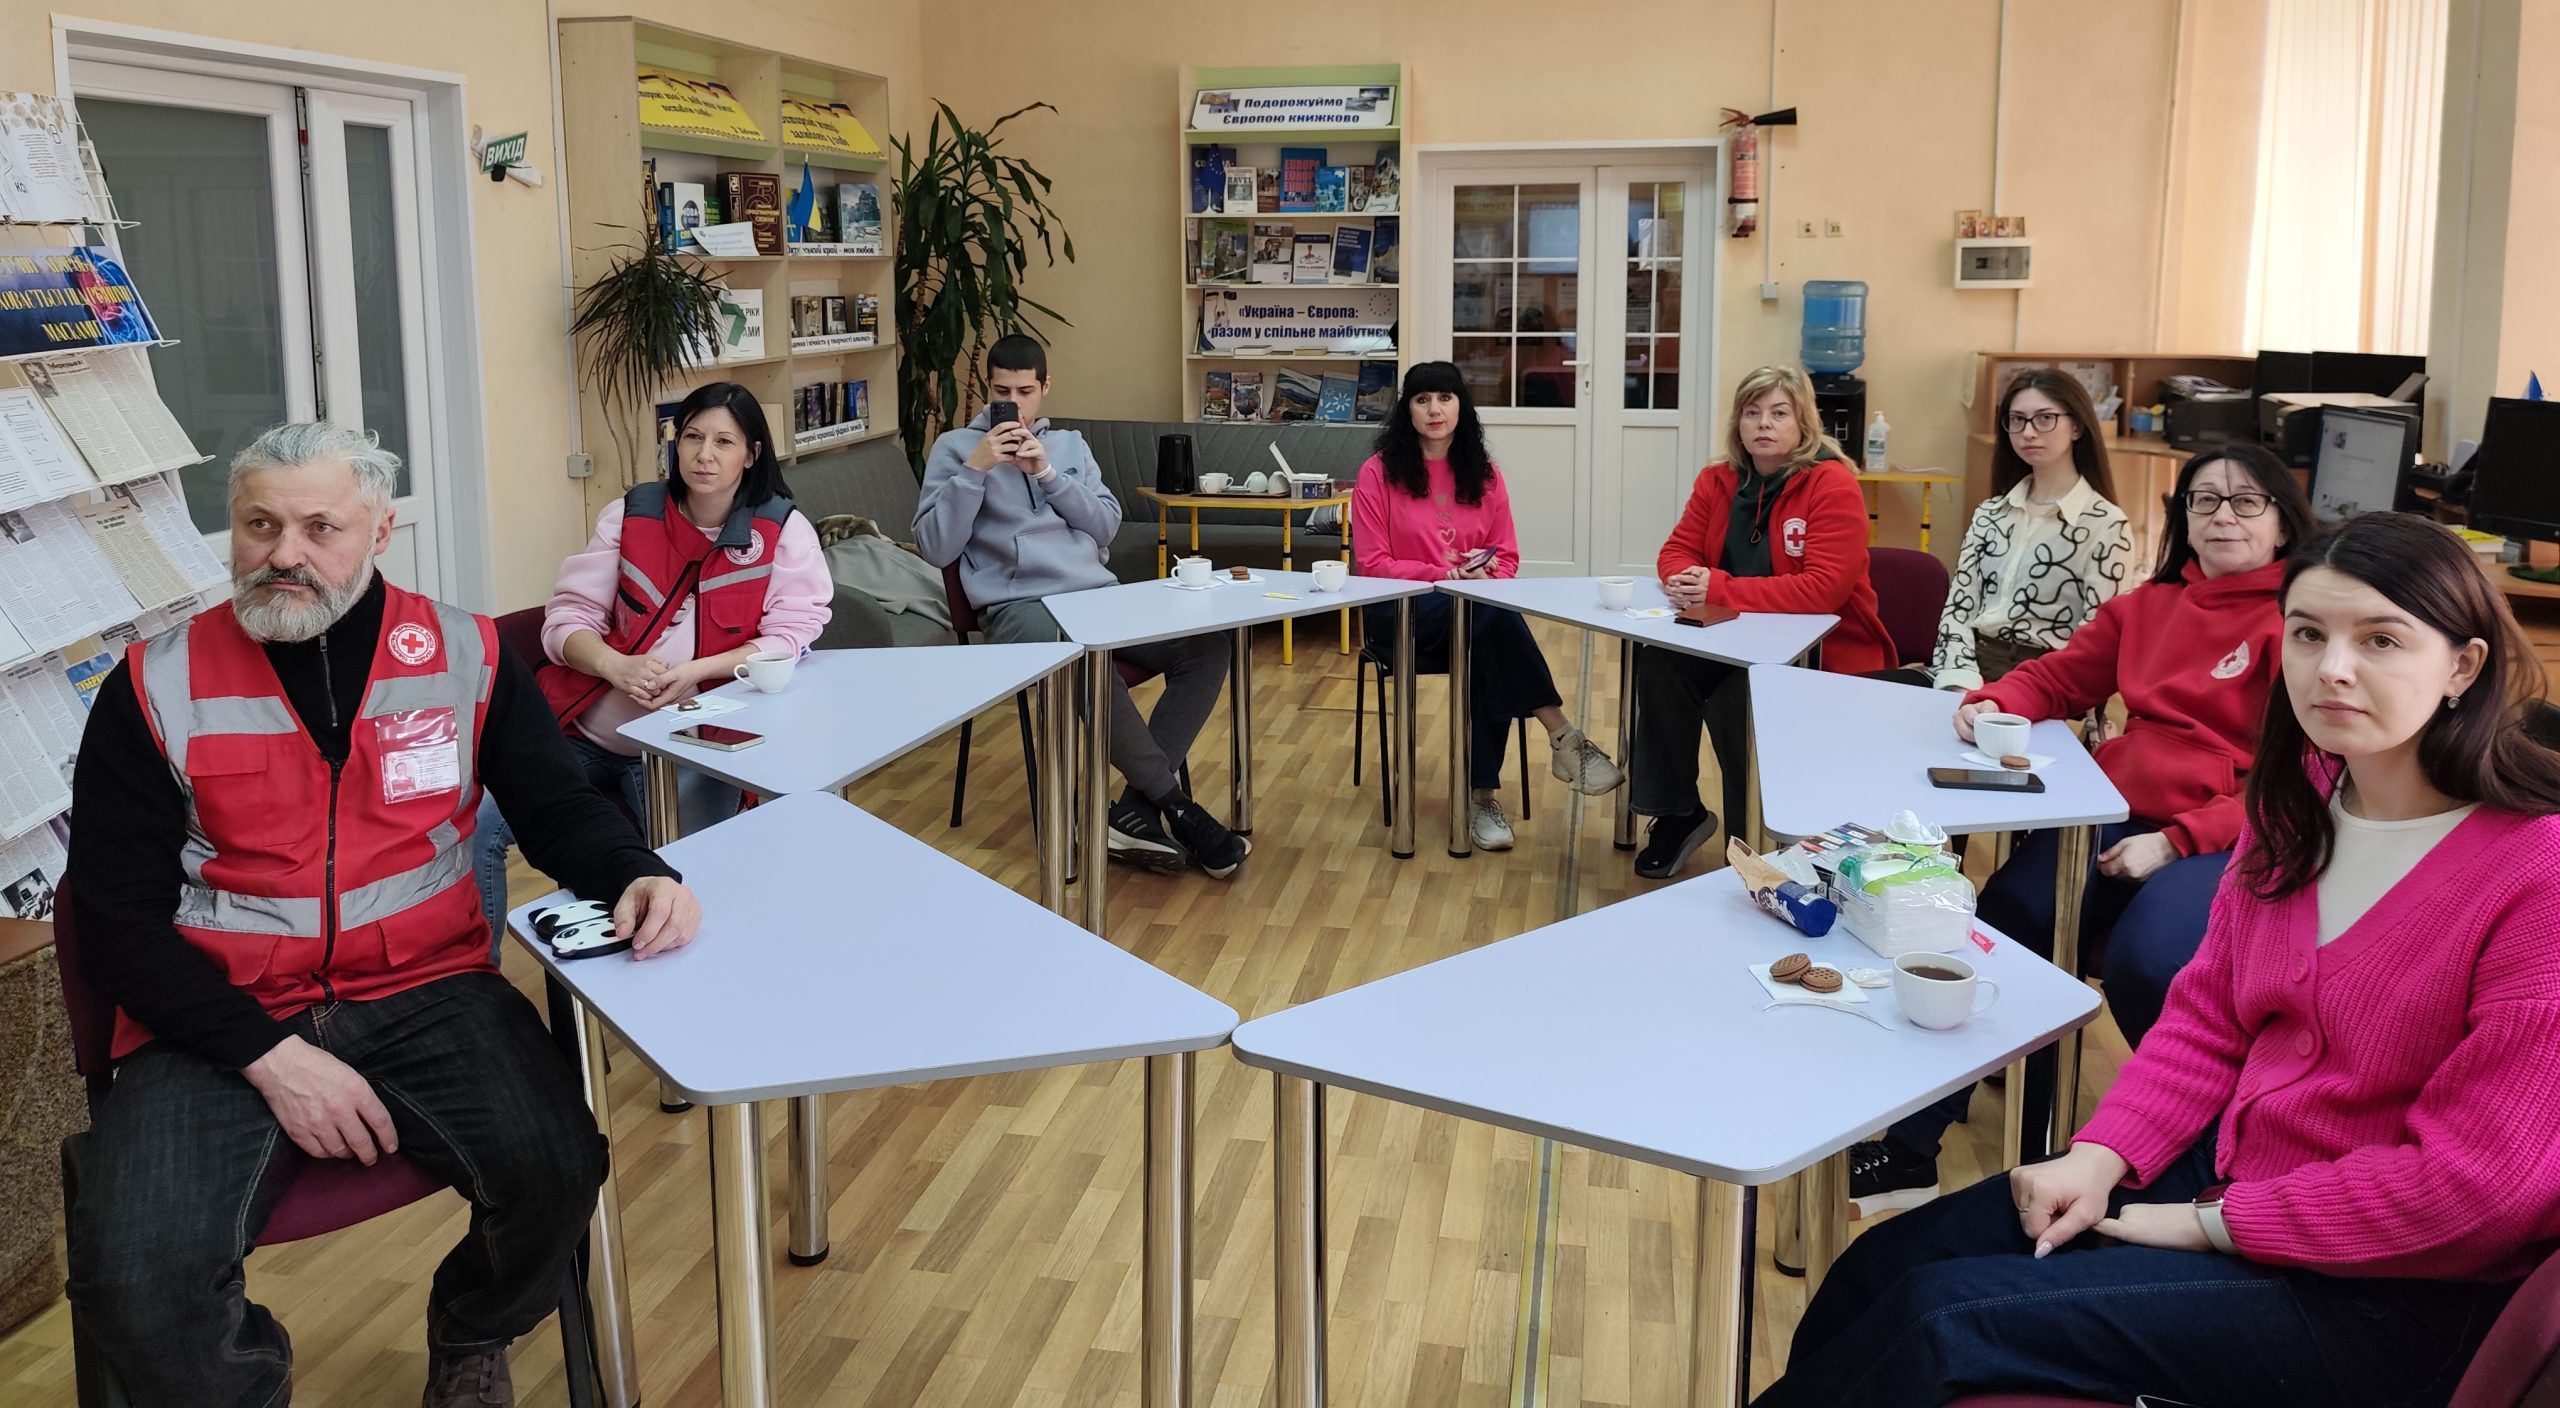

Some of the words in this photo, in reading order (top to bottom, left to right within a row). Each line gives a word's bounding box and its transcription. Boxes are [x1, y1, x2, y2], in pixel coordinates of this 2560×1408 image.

[1244, 98, 1344, 109] Подорожуймо
[1223, 114, 1285, 126] Європою
[1288, 114, 1360, 124] книжково
[485, 137, 526, 167] ВИХІД
[823, 245, 838, 256] край
[856, 246, 874, 254] любов
[1239, 305, 1294, 319] «Україна
[1307, 305, 1359, 319] Європа:
[41, 320, 103, 342] МАСКАМИ
[1211, 326, 1252, 339] разом
[1255, 328, 1262, 339] у
[1264, 325, 1316, 338] спільне
